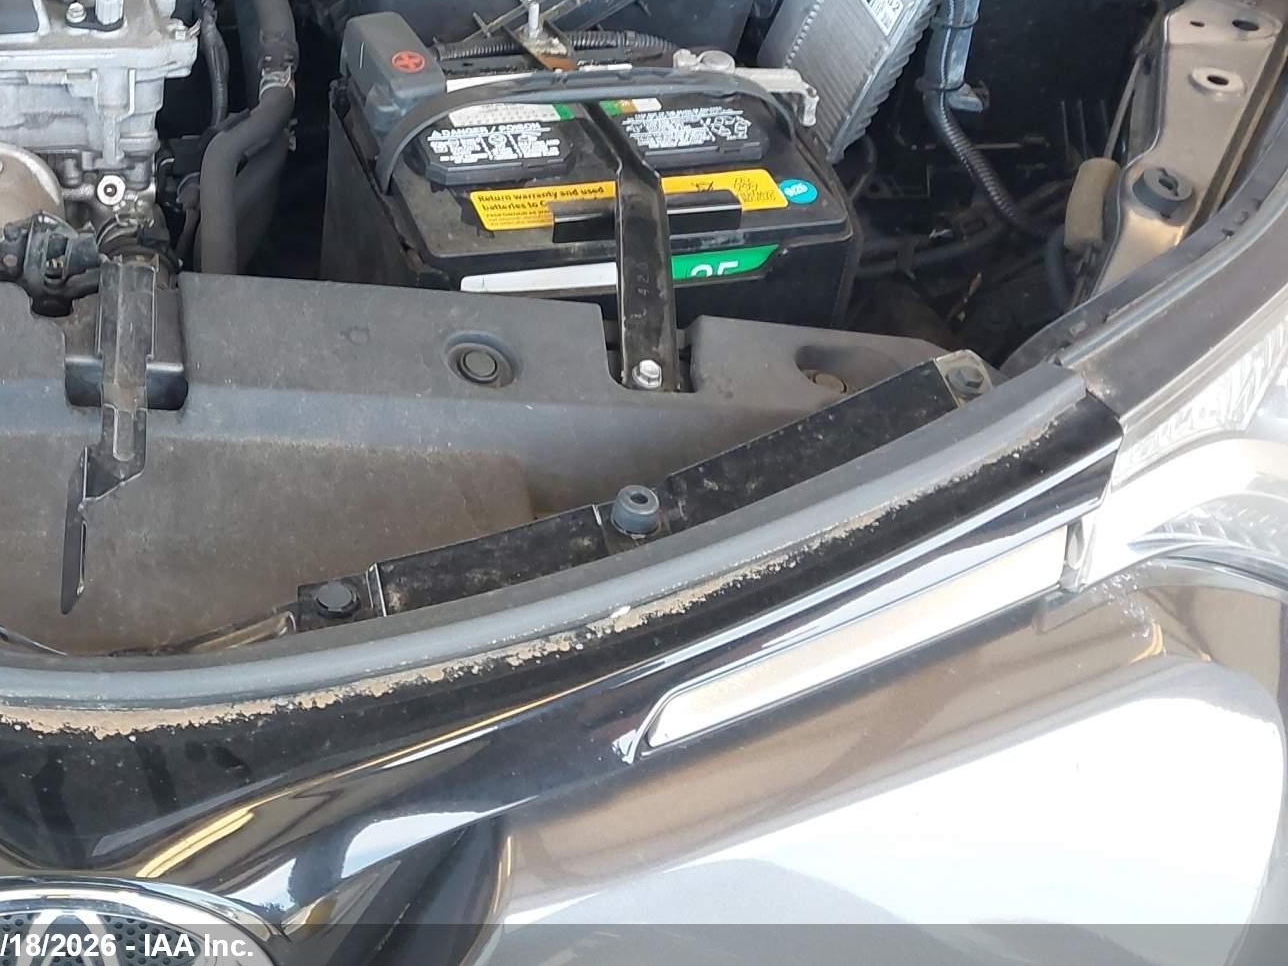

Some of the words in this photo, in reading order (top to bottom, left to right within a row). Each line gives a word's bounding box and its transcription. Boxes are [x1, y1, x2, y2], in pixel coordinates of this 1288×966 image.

[442, 126, 489, 137] DANGER
[497, 122, 542, 132] POISON
[478, 194, 512, 203] Return
[513, 190, 558, 202] warranty
[561, 188, 579, 197] and
[581, 186, 604, 196] used
[482, 201, 527, 211] batteries
[527, 201, 539, 209] to
